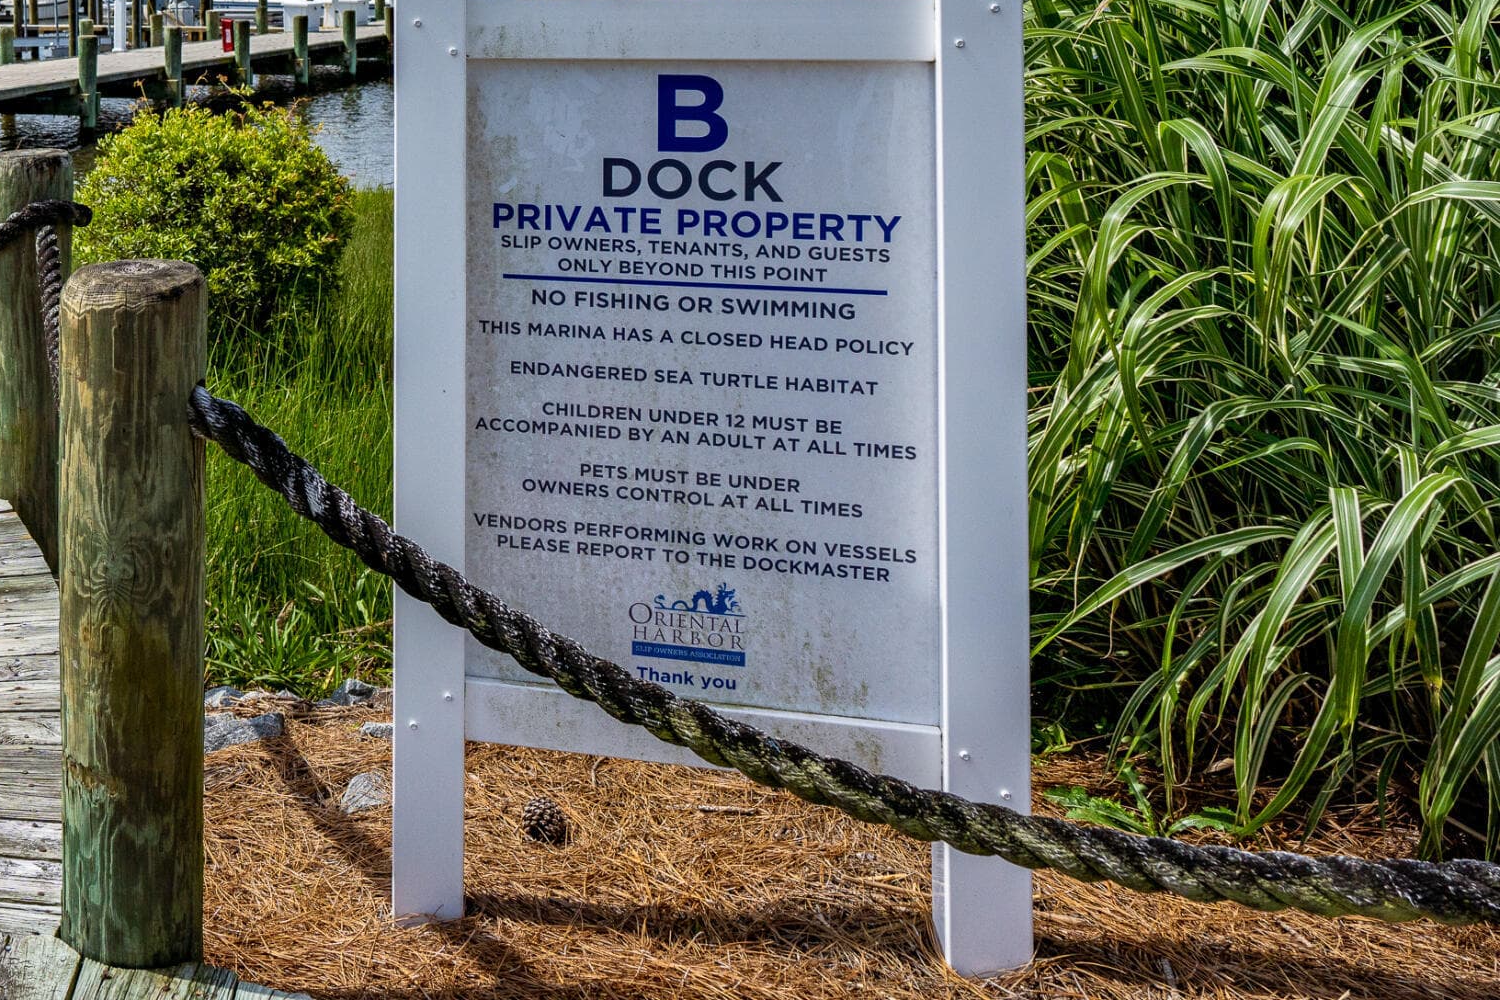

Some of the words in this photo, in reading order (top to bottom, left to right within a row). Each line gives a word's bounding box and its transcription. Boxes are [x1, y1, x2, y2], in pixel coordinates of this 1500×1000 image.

[658, 75, 728, 152] B
[603, 158, 783, 202] DOCK
[493, 203, 661, 234] PRIVATE
[678, 209, 901, 243] PROPERTY
[502, 235, 541, 248] SLIP
[548, 237, 641, 256] OWNERS,
[648, 241, 748, 260] TENANTS,
[756, 245, 800, 259] AND
[808, 247, 890, 263] GUESTS
[558, 258, 612, 273] ONLY
[620, 261, 703, 277] BEYOND
[711, 264, 756, 279] THIS
[764, 267, 827, 282] POINT
[532, 289, 565, 305] NO
[575, 291, 669, 311] FISHING
[678, 296, 712, 313] OR
[722, 298, 855, 320] SWIMMING
[479, 320, 520, 335] THIS
[528, 323, 606, 339] MARINA
[614, 327, 653, 342] HAS
[660, 330, 673, 343] A
[681, 331, 762, 347] CLOSED
[771, 335, 828, 351] HEAD
[836, 339, 914, 355] POLICY
[511, 361, 647, 381] ENDANGERED
[654, 370, 693, 384] SEA
[700, 372, 778, 389] TURTLE
[786, 377, 878, 395] HABITAT
[542, 402, 641, 421] CHILDREN
[649, 409, 718, 426] UNDER
[726, 414, 744, 428] 12
[753, 416, 808, 432] MUST
[816, 420, 842, 434] BE
[475, 417, 621, 439] ACCOMPANIED
[629, 428, 654, 441] BY
[661, 430, 689, 444] AN
[697, 432, 766, 449] ADULT
[773, 438, 800, 452] AT
[807, 440, 846, 455] ALL
[853, 443, 916, 460] TIMES
[581, 464, 627, 479] PETS
[635, 468, 689, 484] MUST
[696, 472, 721, 486] BE
[729, 475, 800, 493] UNDER
[522, 479, 609, 498] OWNERS
[616, 486, 714, 506] CONTROL
[721, 495, 748, 508] AT
[755, 497, 793, 512] ALL
[801, 500, 862, 518] TIMES
[474, 513, 567, 533] VENDORS
[574, 522, 705, 545] PERFORMING
[713, 534, 779, 552] WORK
[786, 540, 816, 555] ON
[824, 543, 916, 563] VESSELS
[498, 535, 570, 553] PLEASE
[577, 542, 656, 560] REPORT
[662, 549, 689, 564] TO
[697, 552, 735, 568] THE
[744, 556, 889, 582] DOCKMASTER
[633, 625, 744, 650] HARBOR
[635, 645, 653, 653] SLIP
[654, 648, 688, 657] OWNERS
[690, 650, 741, 662] ASSOCIATION
[636, 666, 694, 686] Thank
[701, 676, 737, 690] you
